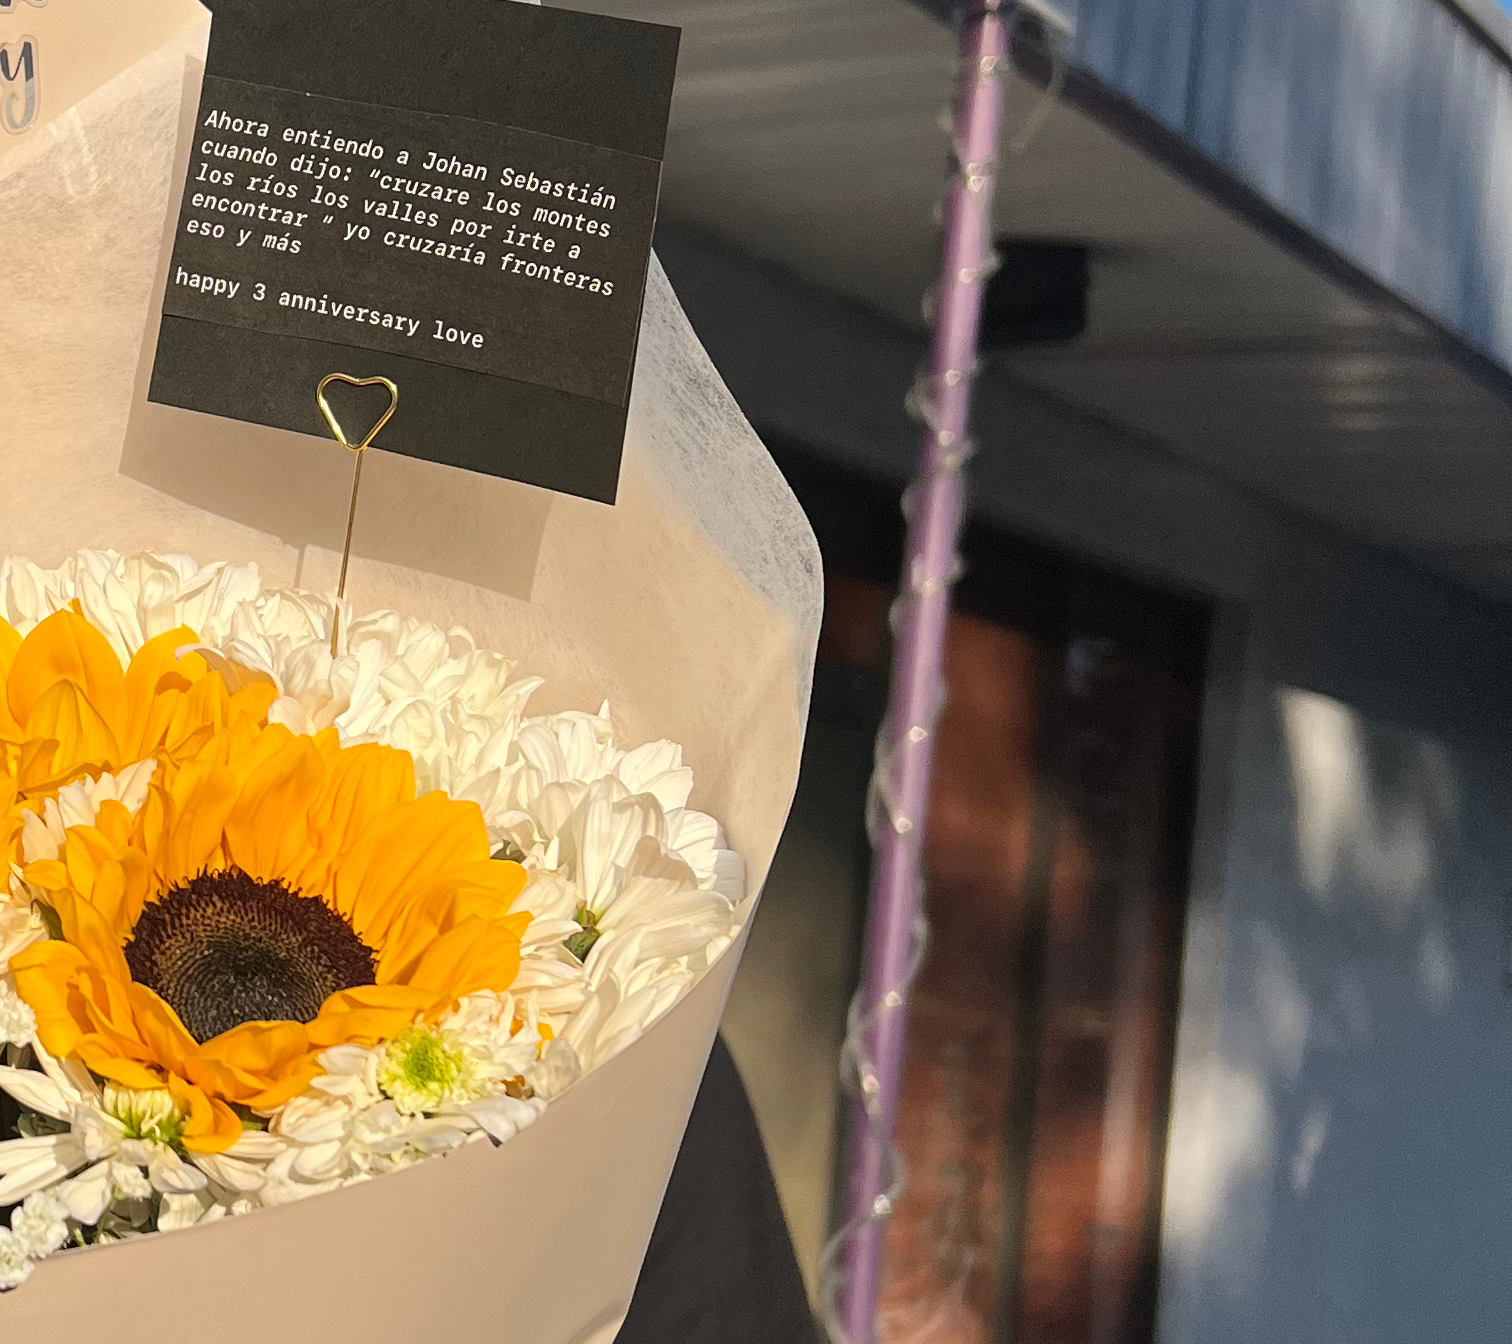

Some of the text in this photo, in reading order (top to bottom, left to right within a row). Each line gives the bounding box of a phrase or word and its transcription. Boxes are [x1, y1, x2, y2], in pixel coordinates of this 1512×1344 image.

[200, 140, 278, 167] cuando
[290, 153, 352, 182] dijo:
[482, 191, 522, 217] los
[532, 206, 612, 238] montes
[204, 109, 616, 210] Ahora entiendo a Johan Sebastián
[186, 219, 302, 254] eso y más
[191, 192, 309, 228] encontrar
[342, 222, 371, 242] yo
[383, 231, 486, 266] cruzaría
[500, 252, 614, 296] fronteras
[194, 162, 581, 260] los ríos los valles por irte a
[175, 266, 484, 348] happy 3 anniversary love
